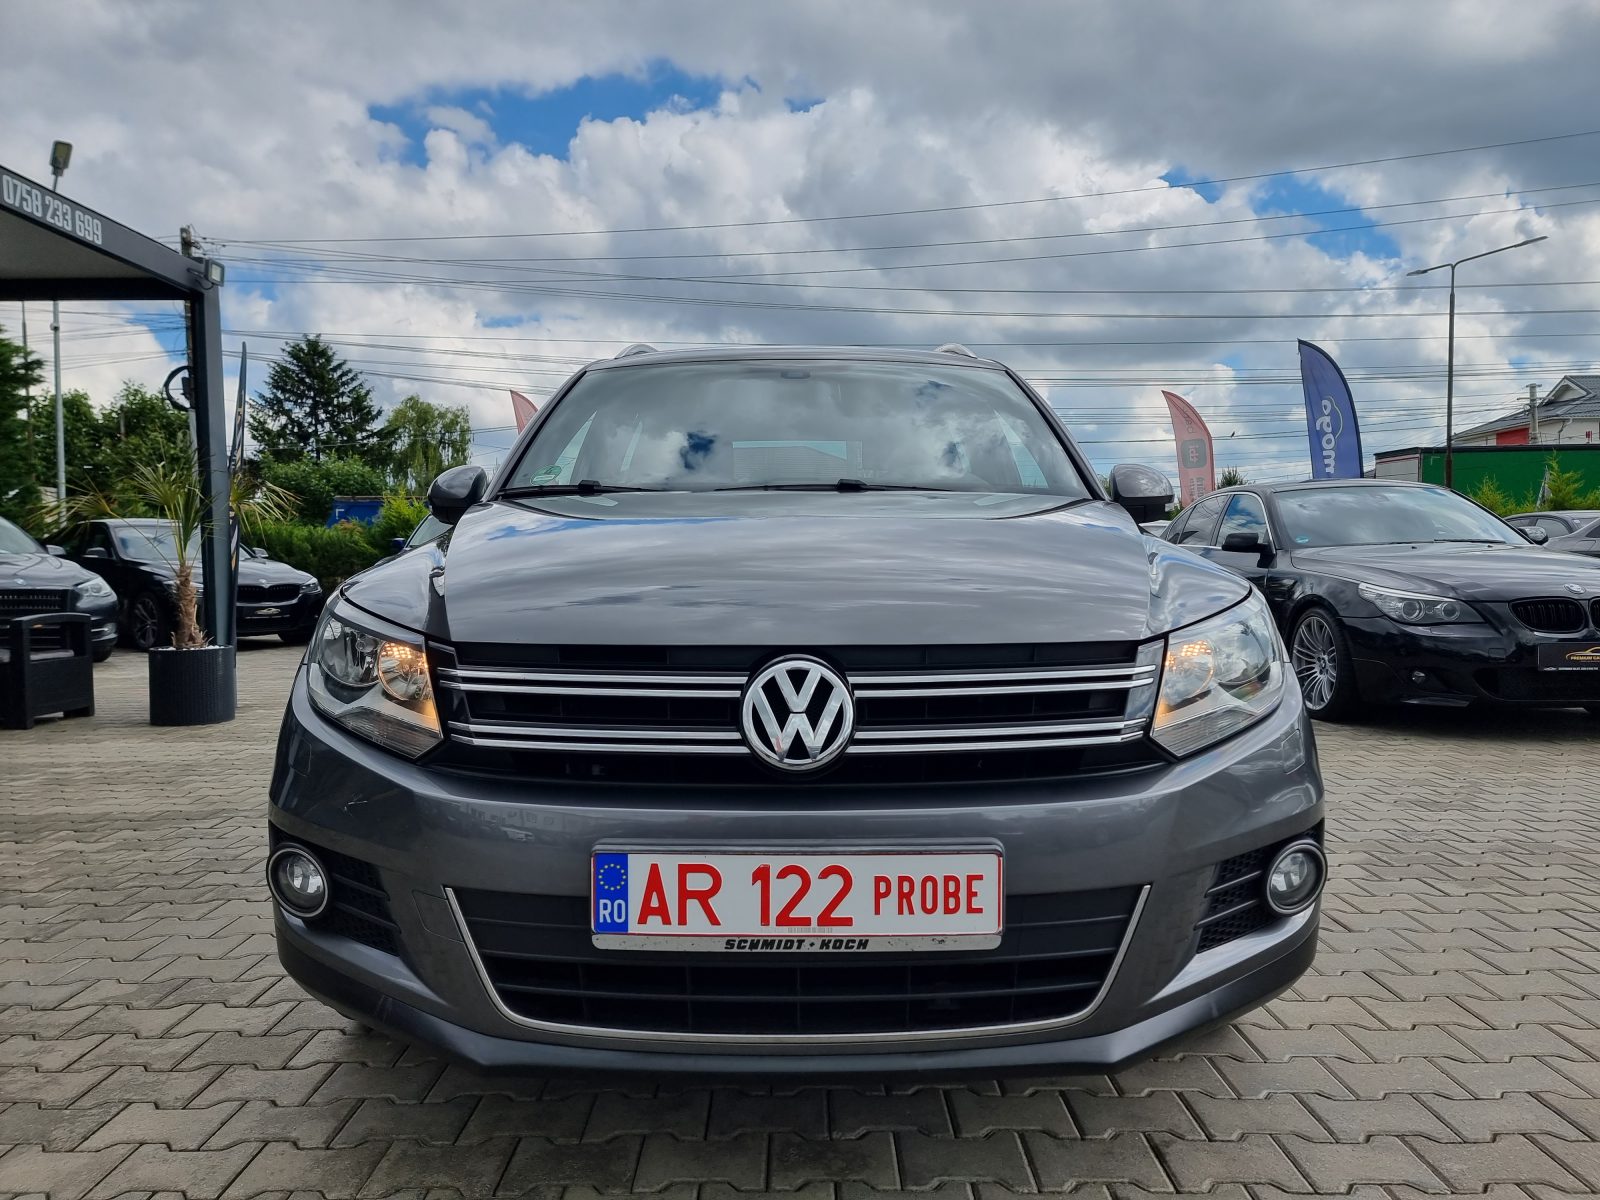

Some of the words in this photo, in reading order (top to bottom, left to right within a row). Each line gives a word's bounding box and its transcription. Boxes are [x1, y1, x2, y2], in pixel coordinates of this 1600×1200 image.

[2, 175, 41, 217] 0758
[45, 196, 73, 231] 233
[75, 211, 102, 245] 699
[599, 899, 626, 923] RO
[637, 863, 723, 926] AR
[751, 864, 854, 927] 122
[875, 873, 985, 915] PROBE
[724, 938, 806, 951] SCHMIDT
[819, 938, 870, 950] KOCH
